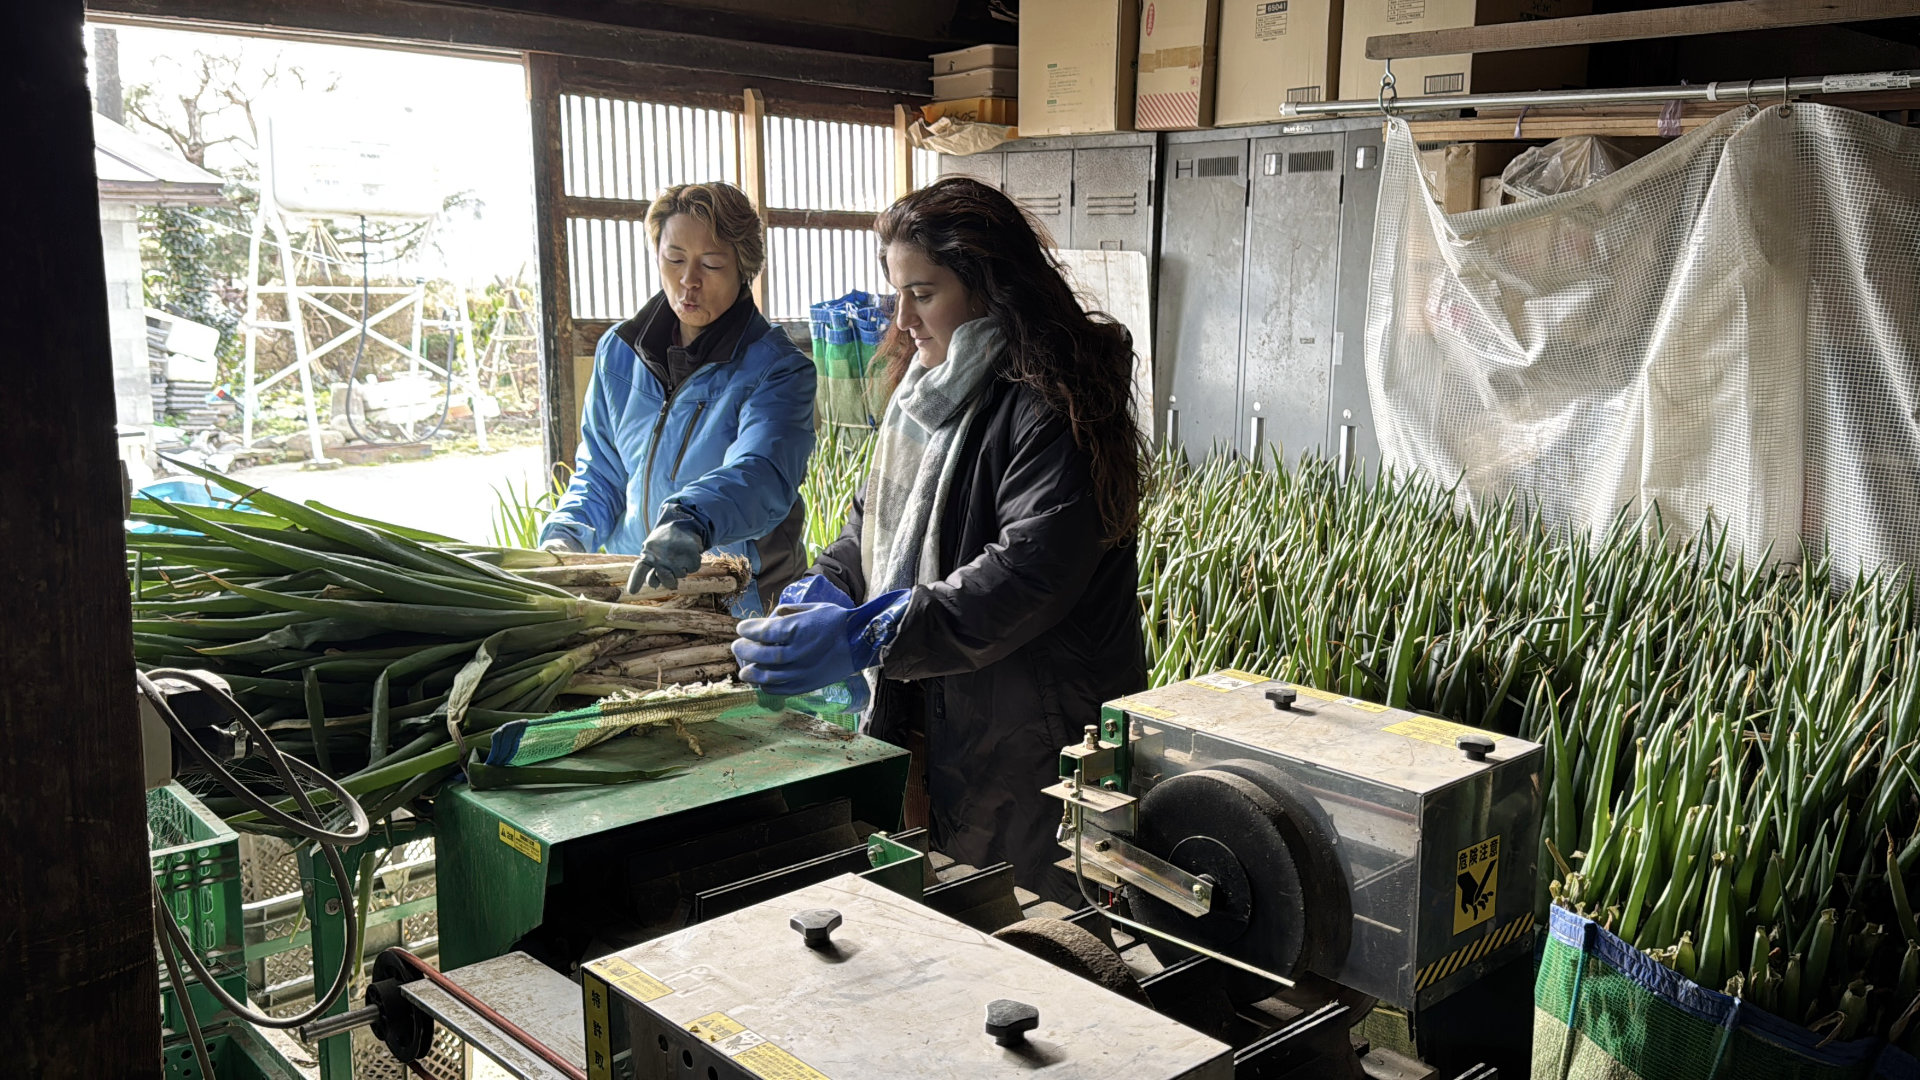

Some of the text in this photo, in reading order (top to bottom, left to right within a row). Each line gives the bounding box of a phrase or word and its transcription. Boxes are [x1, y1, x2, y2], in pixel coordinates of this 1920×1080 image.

[1267, 2, 1287, 13] 65041
[1458, 838, 1499, 872] 危険注意
